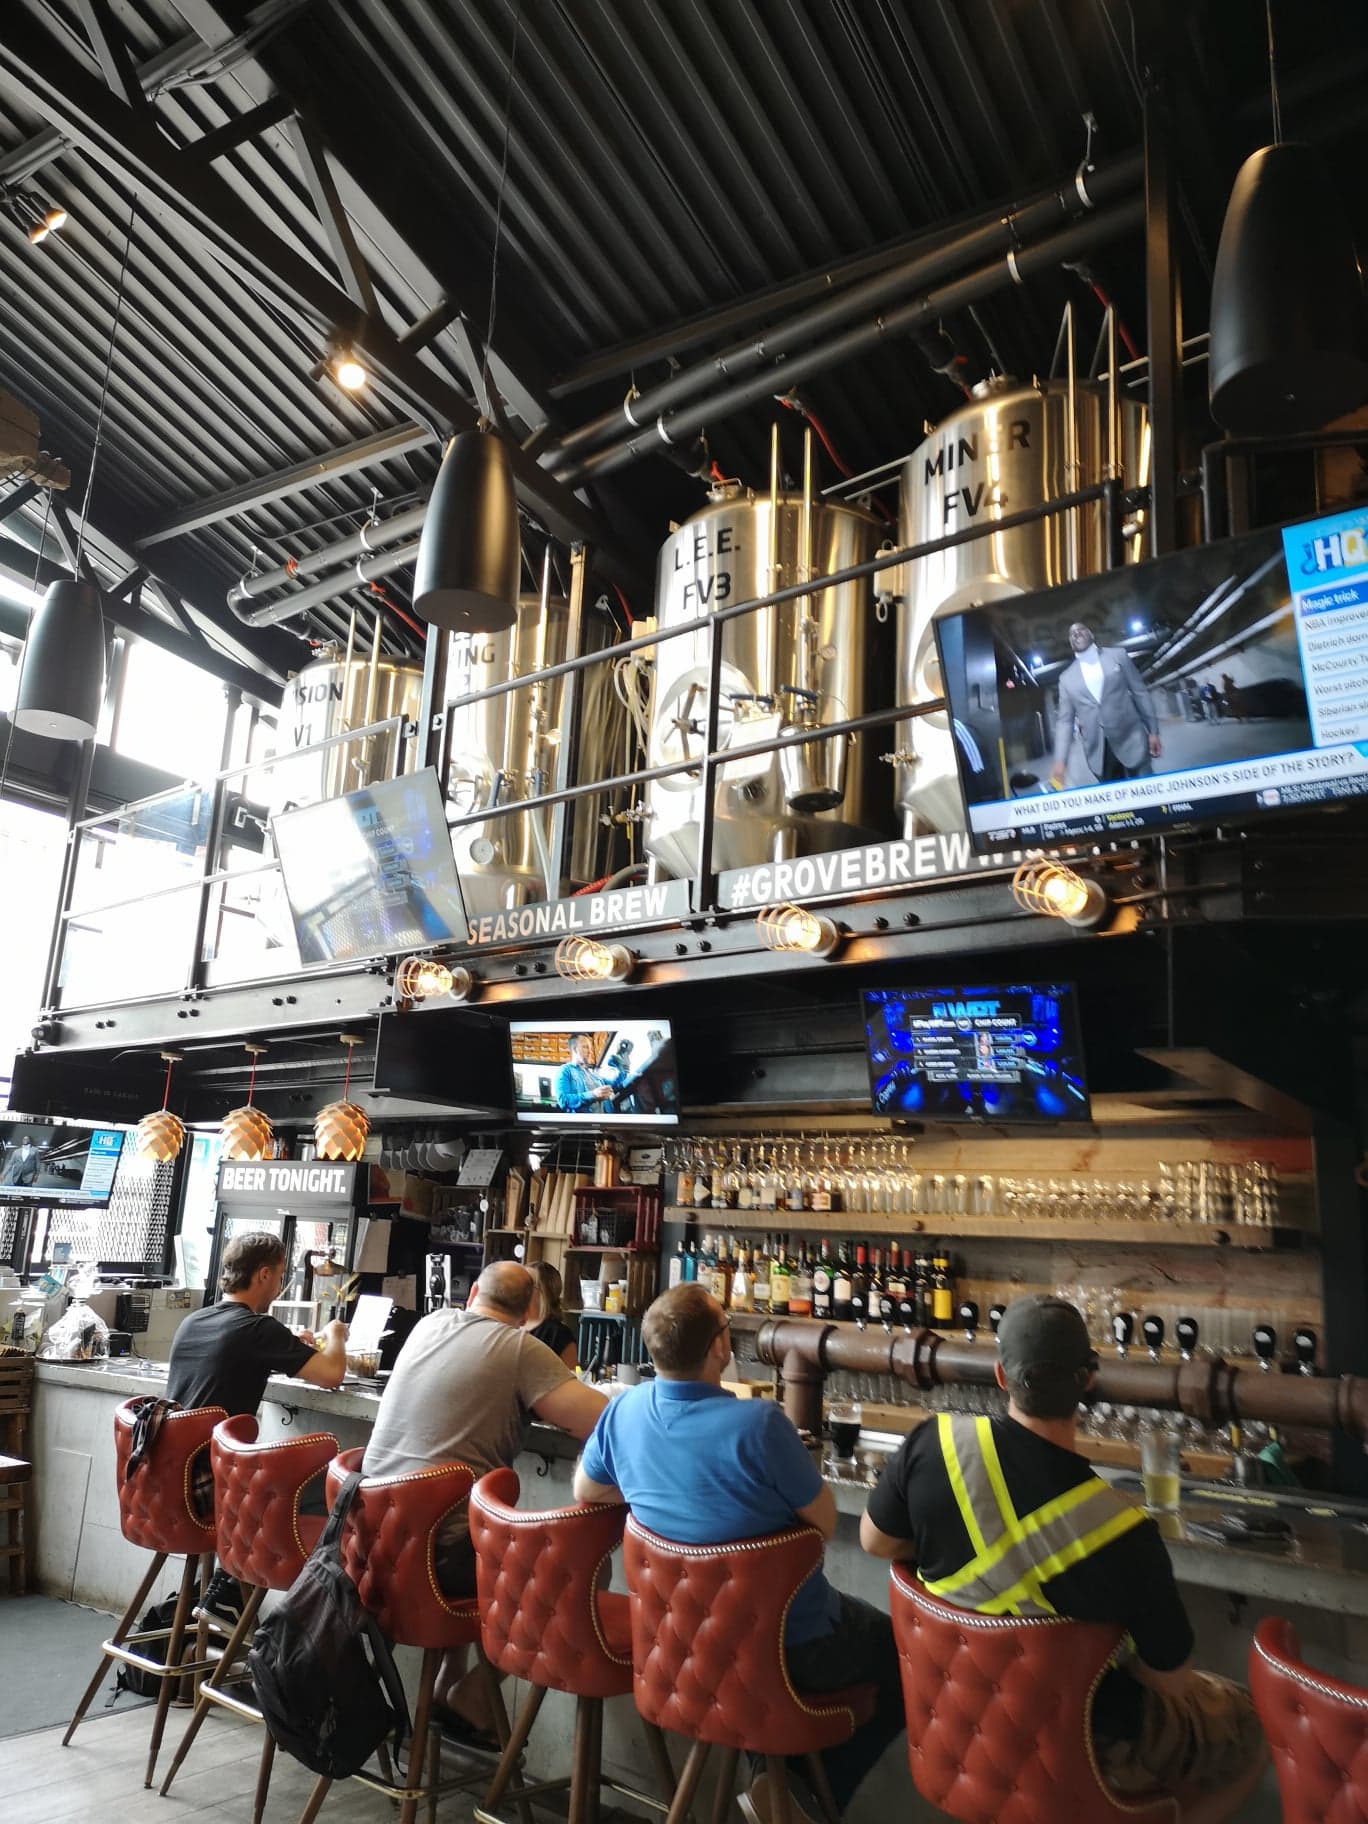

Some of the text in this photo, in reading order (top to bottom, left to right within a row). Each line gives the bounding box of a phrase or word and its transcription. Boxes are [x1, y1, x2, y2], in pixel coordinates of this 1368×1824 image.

[924, 419, 1031, 486] MINR
[943, 481, 1009, 525] FV4
[674, 527, 741, 572] L.E.E.
[683, 571, 732, 610] FV3
[1302, 588, 1360, 611] Magic trick
[293, 681, 344, 706] SION
[1014, 752, 1355, 816] WHAT DID YOU MAKE OF MAGIC JOHNSON'S SIDE OF THE STORY?
[466, 886, 668, 946] SEASONAL BREW
[222, 1167, 346, 1194] BEER TONIGHT.
